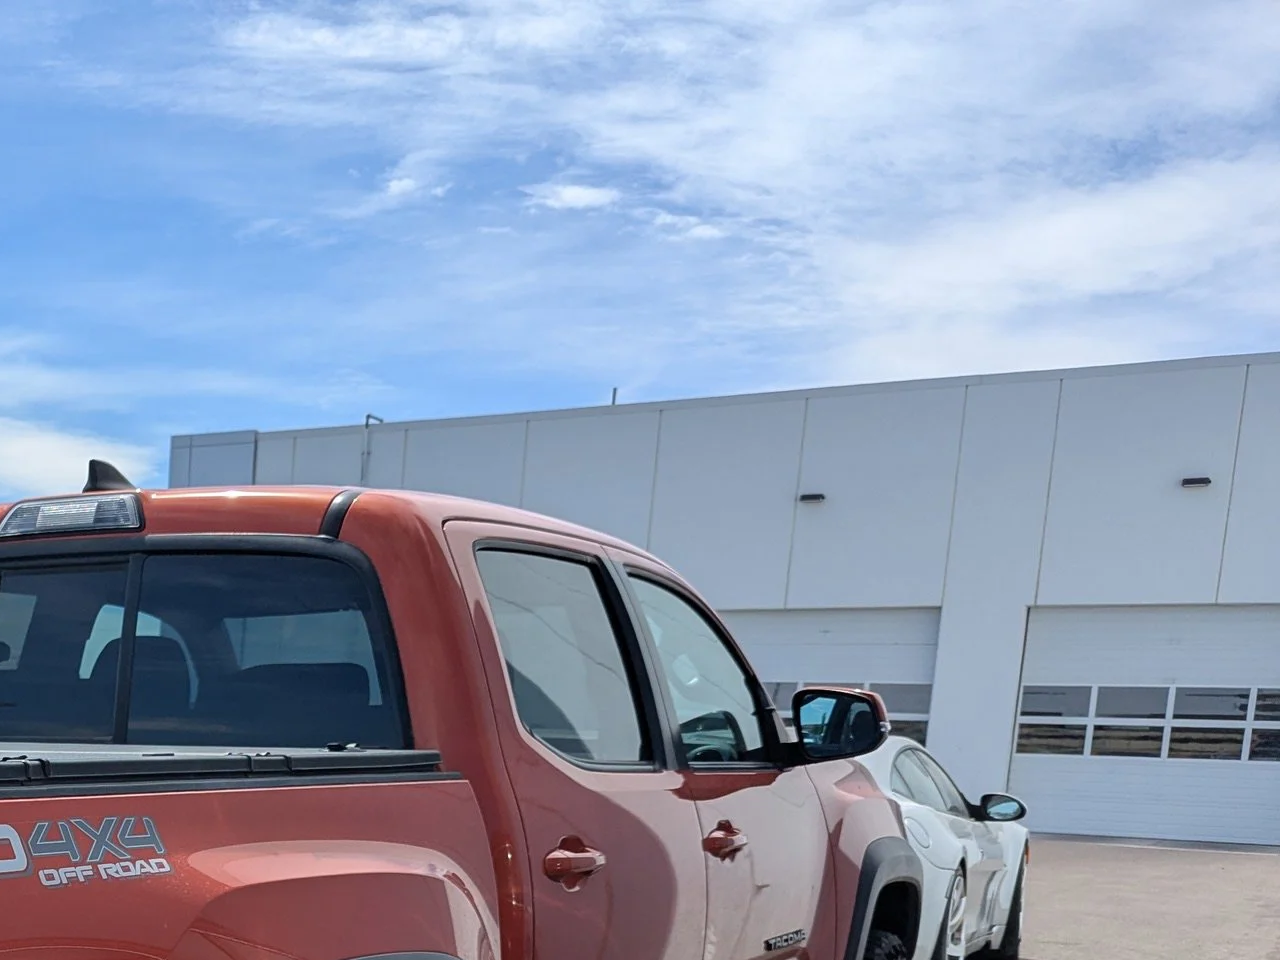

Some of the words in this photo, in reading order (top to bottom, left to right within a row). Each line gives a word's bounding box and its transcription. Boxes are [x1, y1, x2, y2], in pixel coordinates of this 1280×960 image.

[38, 864, 94, 887] OFF
[99, 857, 172, 881] ROAD
[767, 929, 808, 950] TACOMA
